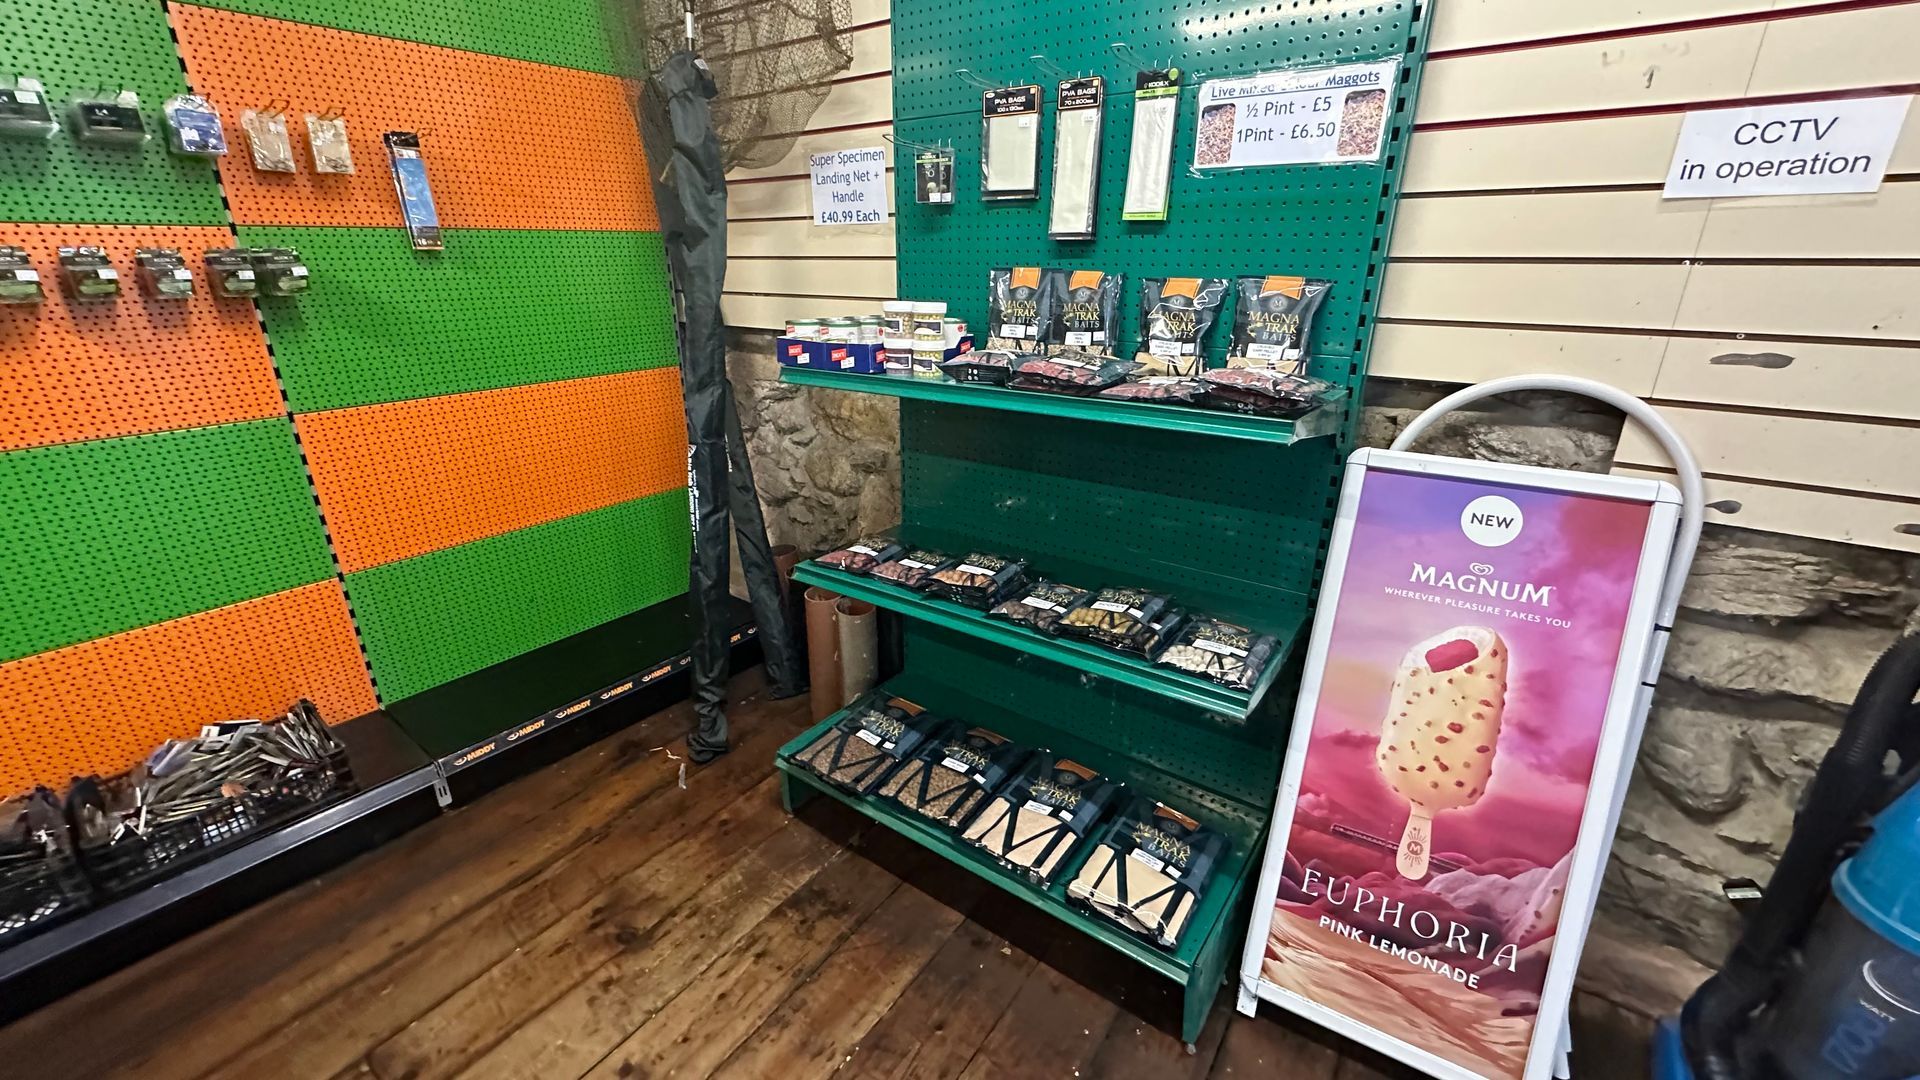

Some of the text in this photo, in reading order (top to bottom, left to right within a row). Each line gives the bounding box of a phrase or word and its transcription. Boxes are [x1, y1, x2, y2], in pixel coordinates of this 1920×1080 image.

[1061, 87, 1097, 97] PVA BAGS
[1211, 86, 1236, 98] Live
[1325, 71, 1380, 87] Maggots
[1008, 95, 1026, 104] BAGS
[1264, 101, 1294, 117] Pint
[1312, 96, 1332, 112] £5
[1236, 127, 1274, 143] 1Pint
[1290, 121, 1336, 139] £6.50
[1733, 116, 1840, 146] CCTV
[809, 149, 885, 168] Super Specimen
[1679, 151, 1872, 183] in operation
[815, 171, 851, 186] Landing
[853, 170, 871, 182] Net
[832, 189, 864, 203] Handle
[821, 208, 881, 223] £40.99 Each
[1003, 300, 1037, 309] MAGNA
[1013, 308, 1036, 317] TRAK
[1063, 302, 1100, 312] MAGNA
[1011, 315, 1036, 324] BAITS
[1074, 320, 1100, 328] BAITS
[1075, 311, 1100, 321] TRAK
[1248, 311, 1300, 324] MAGNA
[1265, 322, 1297, 334] TRAK
[1262, 333, 1297, 343] BAITS
[1470, 512, 1515, 529] NEW
[1408, 562, 1552, 607] MAGNUM
[1384, 585, 1572, 629] WHEREVER PLEASURE TAKES YOU
[651, 665, 672, 679] MIDDY
[611, 681, 633, 697] MIDDY
[566, 698, 592, 715] MIDDY
[519, 719, 545, 737] MIDDY
[870, 724, 897, 742] BAITS
[876, 719, 903, 737] TRAK
[466, 742, 496, 761] MIDDY
[960, 749, 989, 766] TRAK
[954, 753, 983, 770] BAITS
[1040, 794, 1075, 810] BAITS
[1047, 789, 1080, 805] TRAK
[1136, 822, 1190, 854] MAGNA
[1147, 843, 1186, 868] BAITS
[1153, 837, 1190, 862] TRAK
[1301, 867, 1519, 973] EUPHORIA
[1319, 914, 1481, 990] PINK LEMONADE
